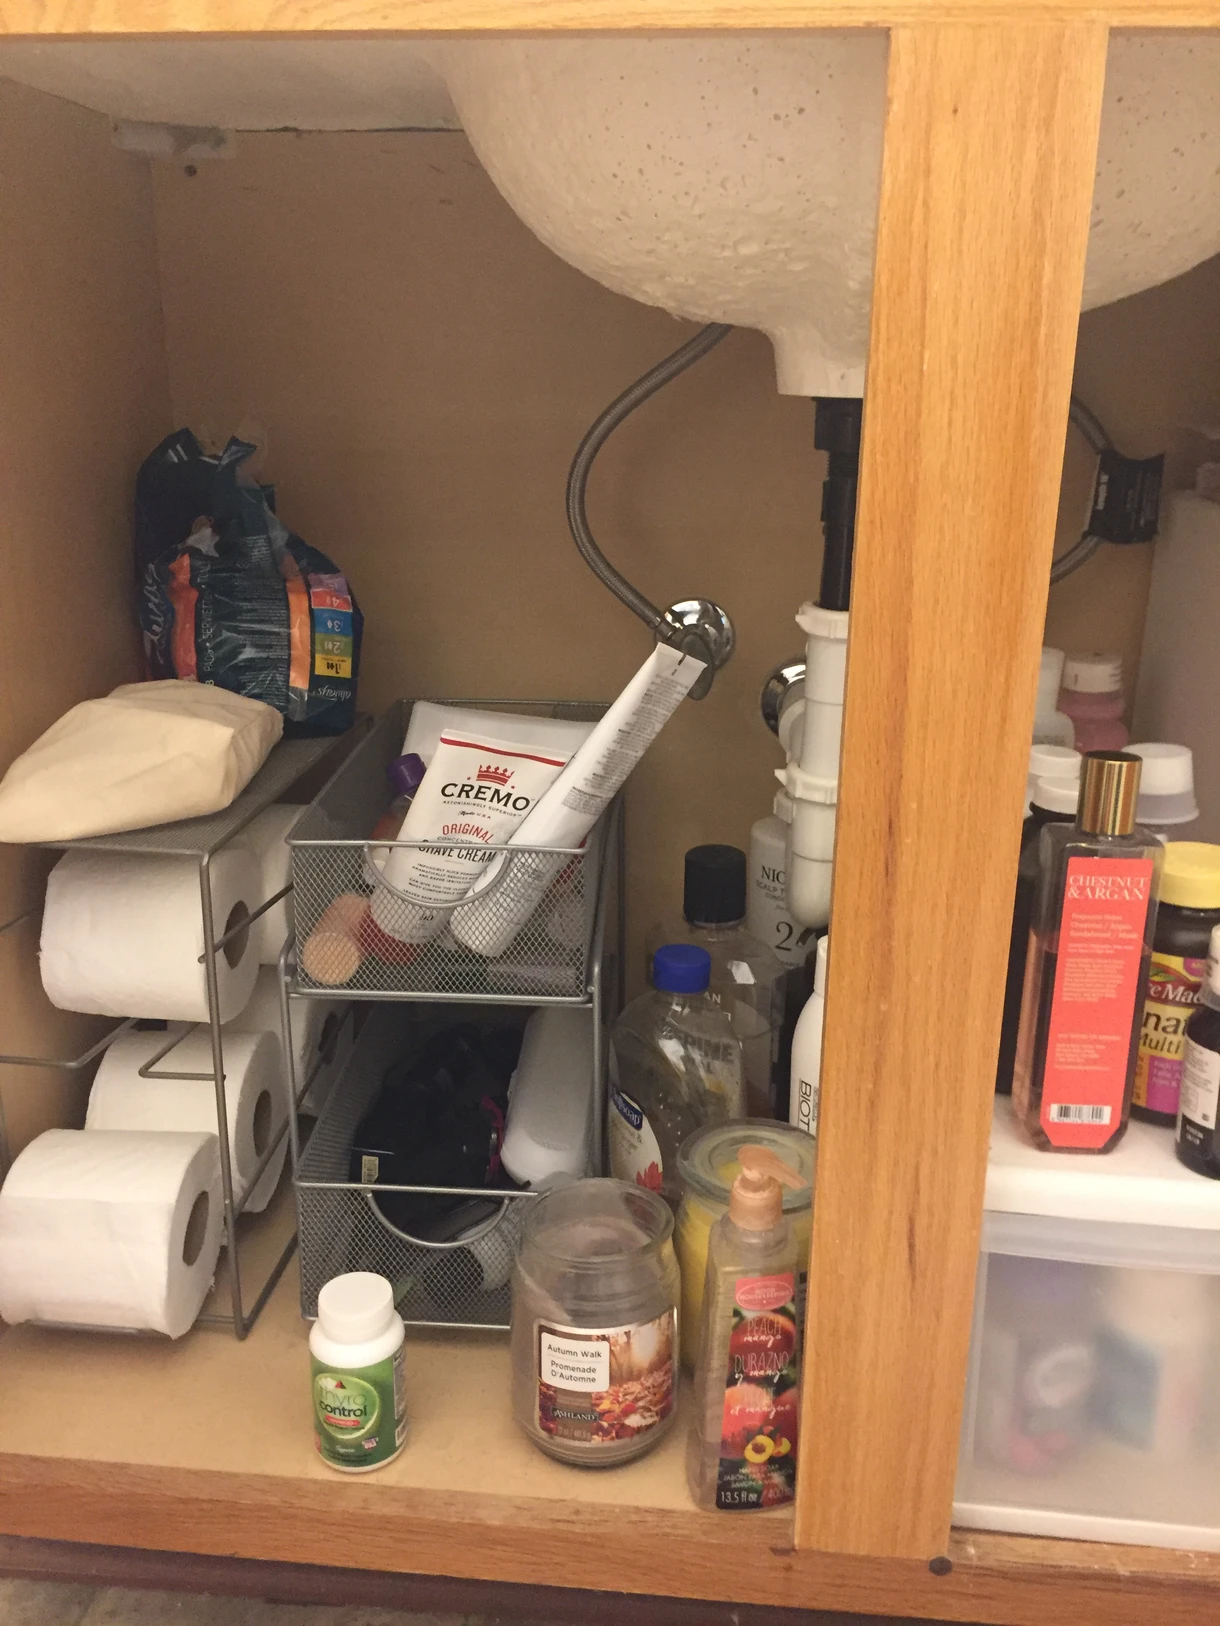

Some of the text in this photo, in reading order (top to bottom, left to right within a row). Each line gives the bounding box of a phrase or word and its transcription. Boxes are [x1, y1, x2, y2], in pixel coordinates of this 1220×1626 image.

[333, 642, 341, 653] 2
[318, 685, 351, 701] always
[440, 783, 531, 811] CREMO
[443, 800, 487, 809] ASTONISHINGLY
[442, 823, 494, 844] ORIGINAL
[418, 839, 497, 863] SHAVE CREAM
[1069, 875, 1149, 888] CHESTNUT
[1068, 886, 1145, 900] & ARGAN
[775, 921, 794, 952] 2
[800, 1080, 812, 1132] BIOT
[747, 1318, 781, 1336] PEACH
[743, 1334, 782, 1348] mango
[547, 1344, 602, 1358] Autumn Walk
[551, 1360, 597, 1374] Promenade
[734, 1351, 789, 1373] DURAZNO
[551, 1370, 596, 1383] D'Automne
[320, 1401, 367, 1417] control
[554, 1409, 596, 1420] ASHLAND
[721, 1491, 739, 1503] 13.5
